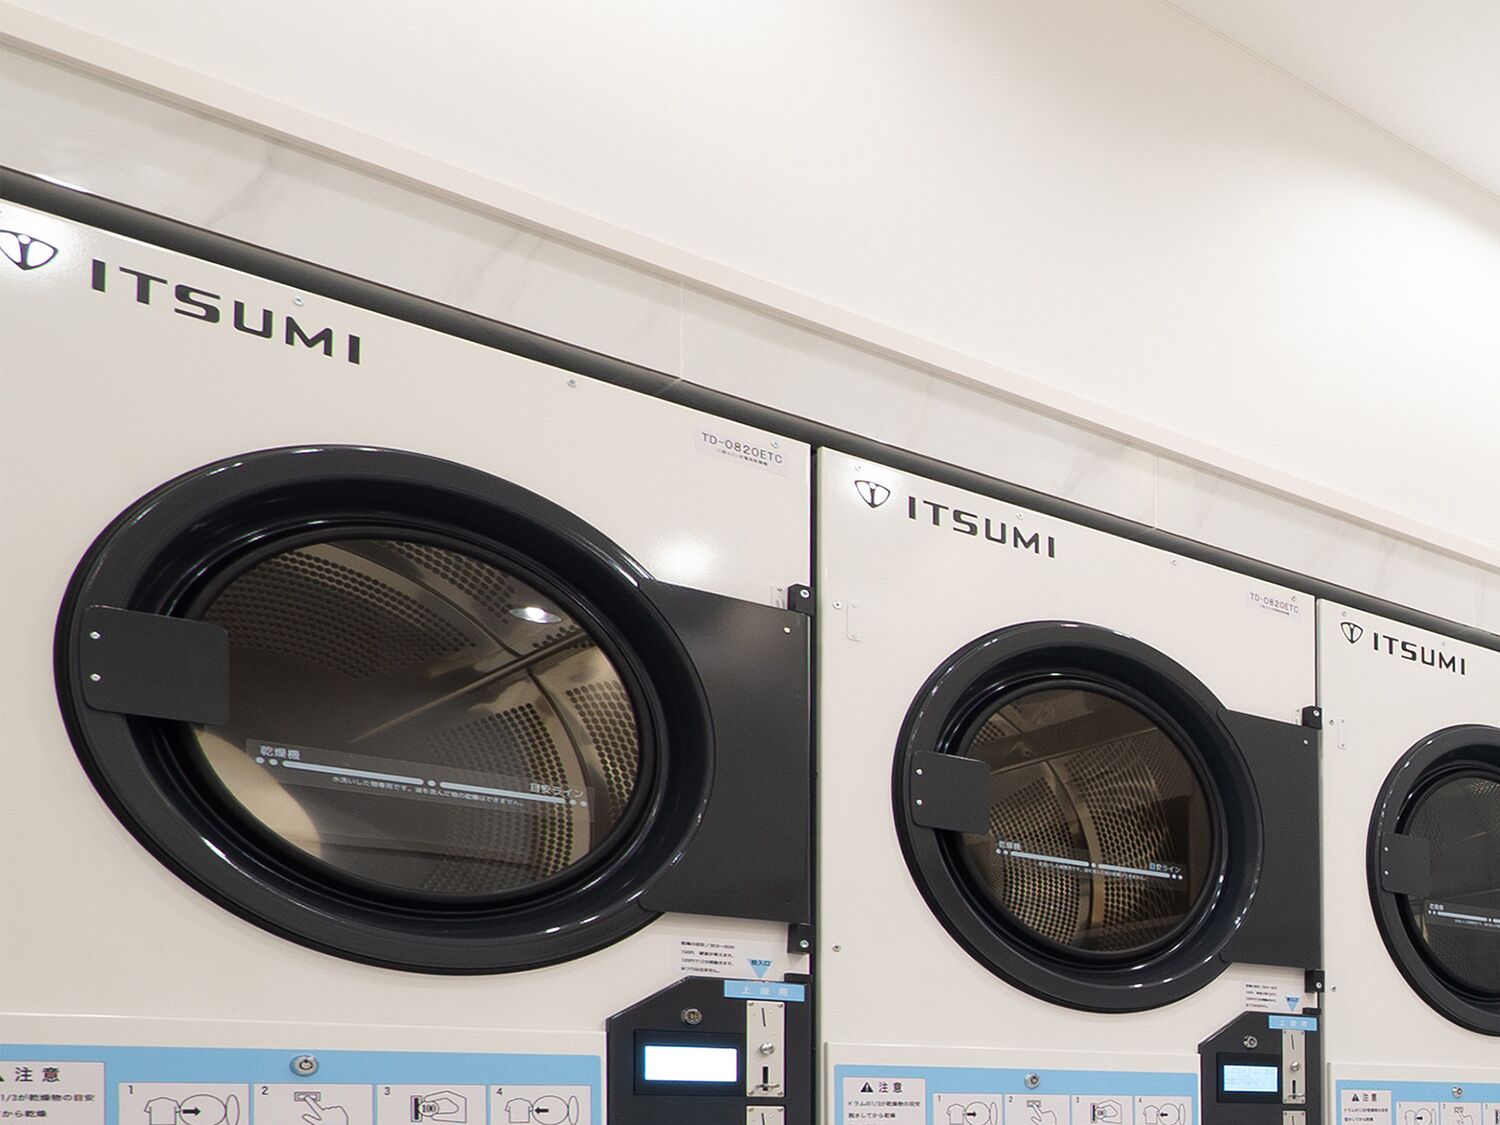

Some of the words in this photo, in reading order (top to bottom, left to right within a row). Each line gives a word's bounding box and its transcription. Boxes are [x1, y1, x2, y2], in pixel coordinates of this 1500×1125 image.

[91, 258, 361, 365] ITSUMI
[701, 432, 783, 464] TD-0820ETC
[908, 495, 1055, 558] ITSUMI
[1373, 632, 1465, 675] ITSUMI
[529, 783, 584, 798] 目安ライン
[15, 1066, 60, 1082] 注意
[128, 1085, 133, 1095] 1
[261, 1086, 268, 1096] 2
[384, 1087, 391, 1095] 3
[496, 1087, 503, 1096] 4
[878, 1082, 903, 1093] 注意
